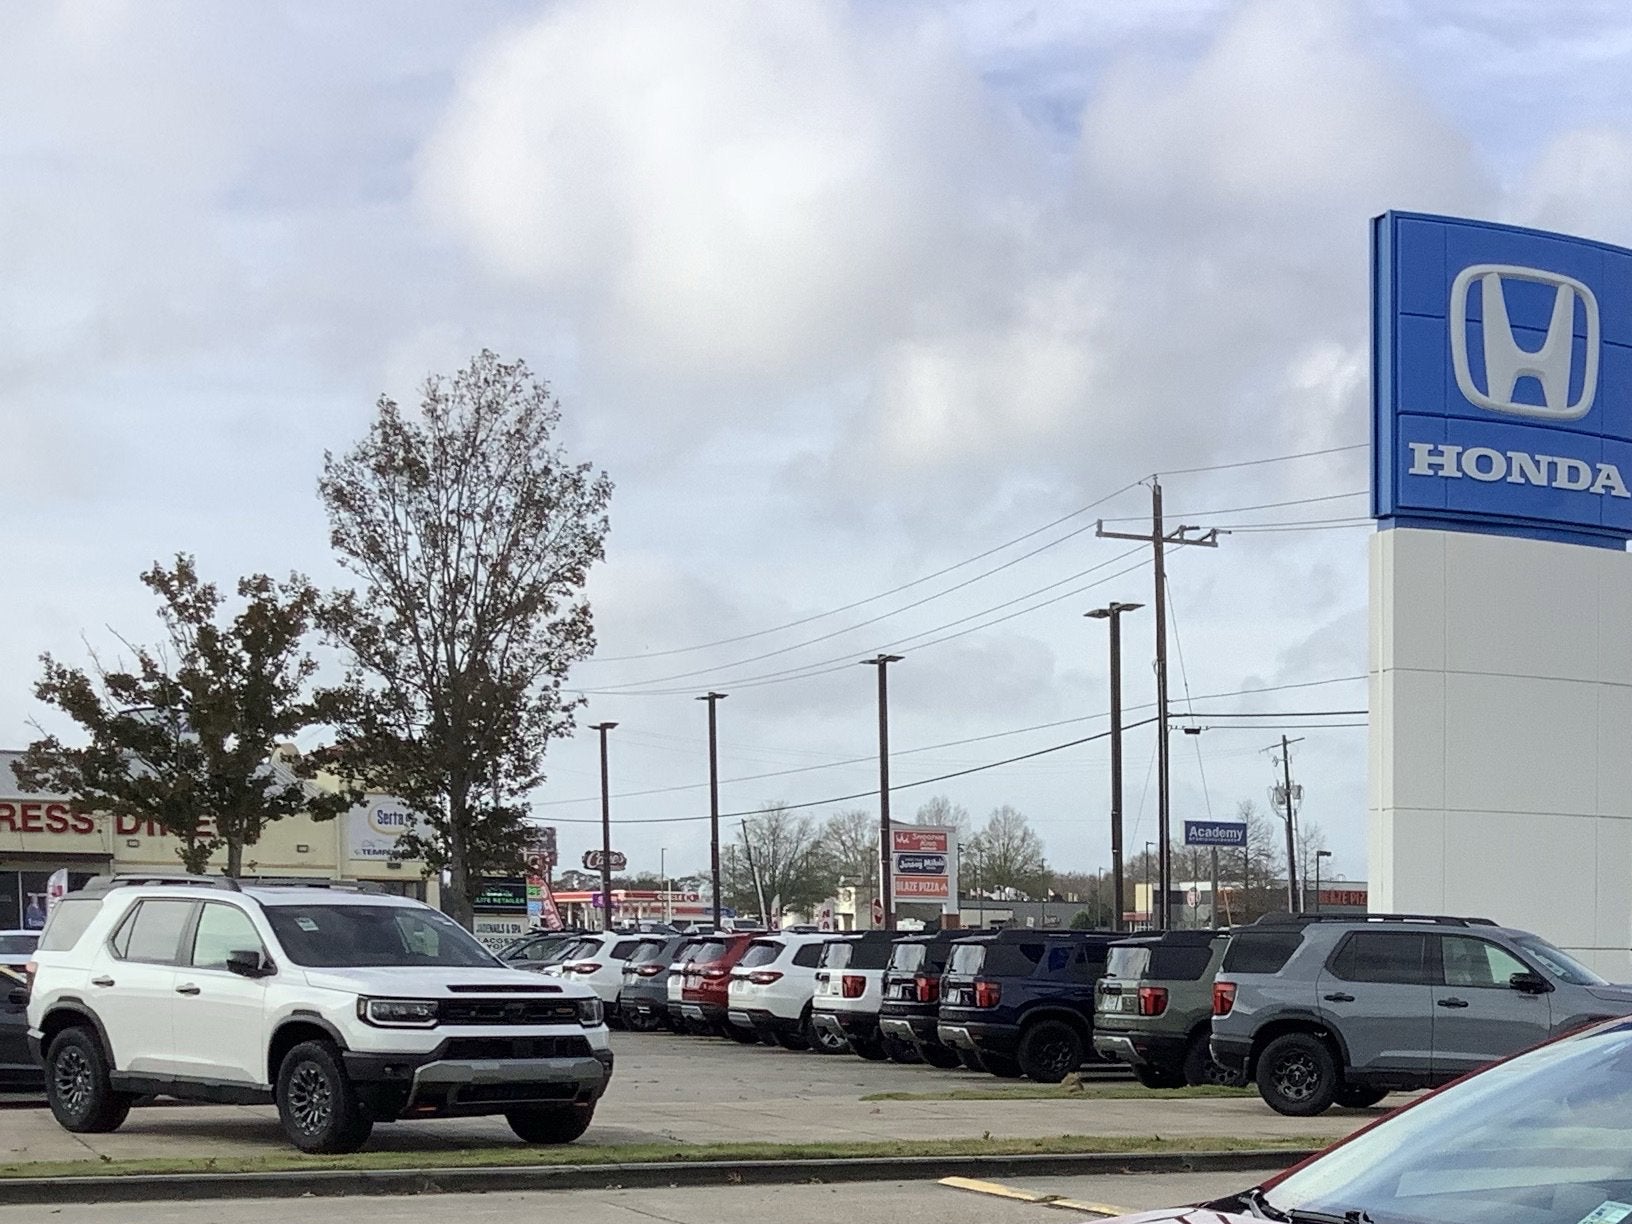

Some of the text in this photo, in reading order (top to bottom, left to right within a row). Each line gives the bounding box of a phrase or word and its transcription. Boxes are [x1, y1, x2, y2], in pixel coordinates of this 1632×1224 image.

[1408, 442, 1631, 498] HONDA
[377, 809, 404, 825] Serta
[1189, 826, 1243, 841] Academy
[919, 881, 940, 893] PIZZA
